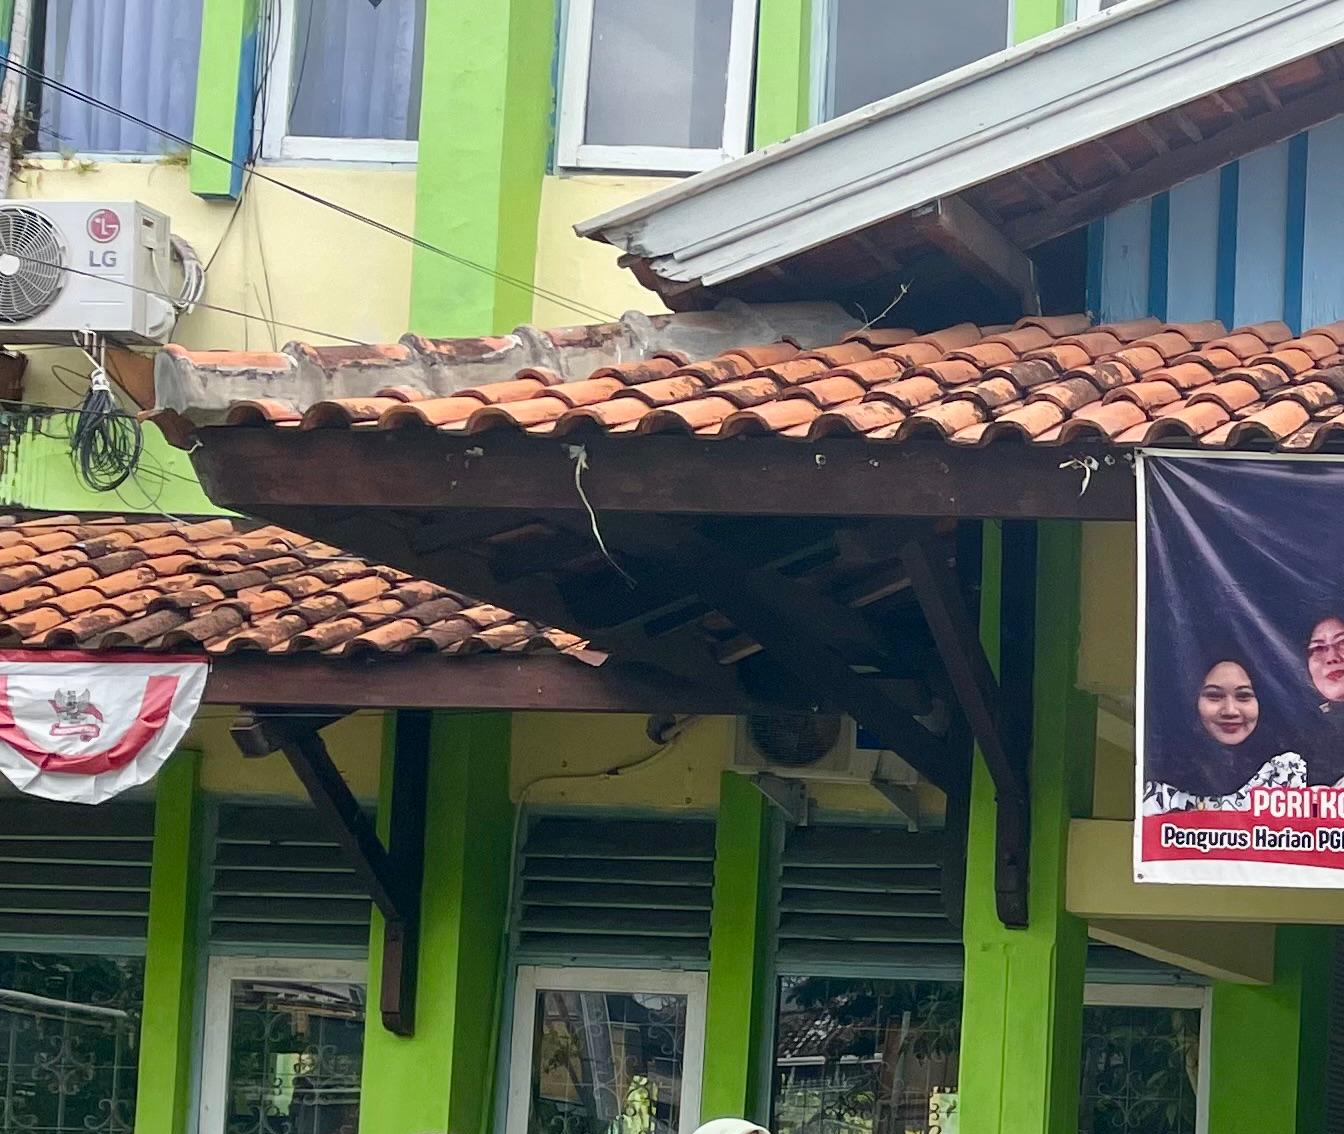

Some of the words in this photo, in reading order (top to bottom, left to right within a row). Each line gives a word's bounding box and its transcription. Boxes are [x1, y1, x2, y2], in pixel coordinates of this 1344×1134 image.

[89, 250, 117, 267] LG
[1254, 789, 1310, 818] PGRI
[1164, 826, 1249, 850] Pengurus
[1256, 828, 1311, 849] Harian
